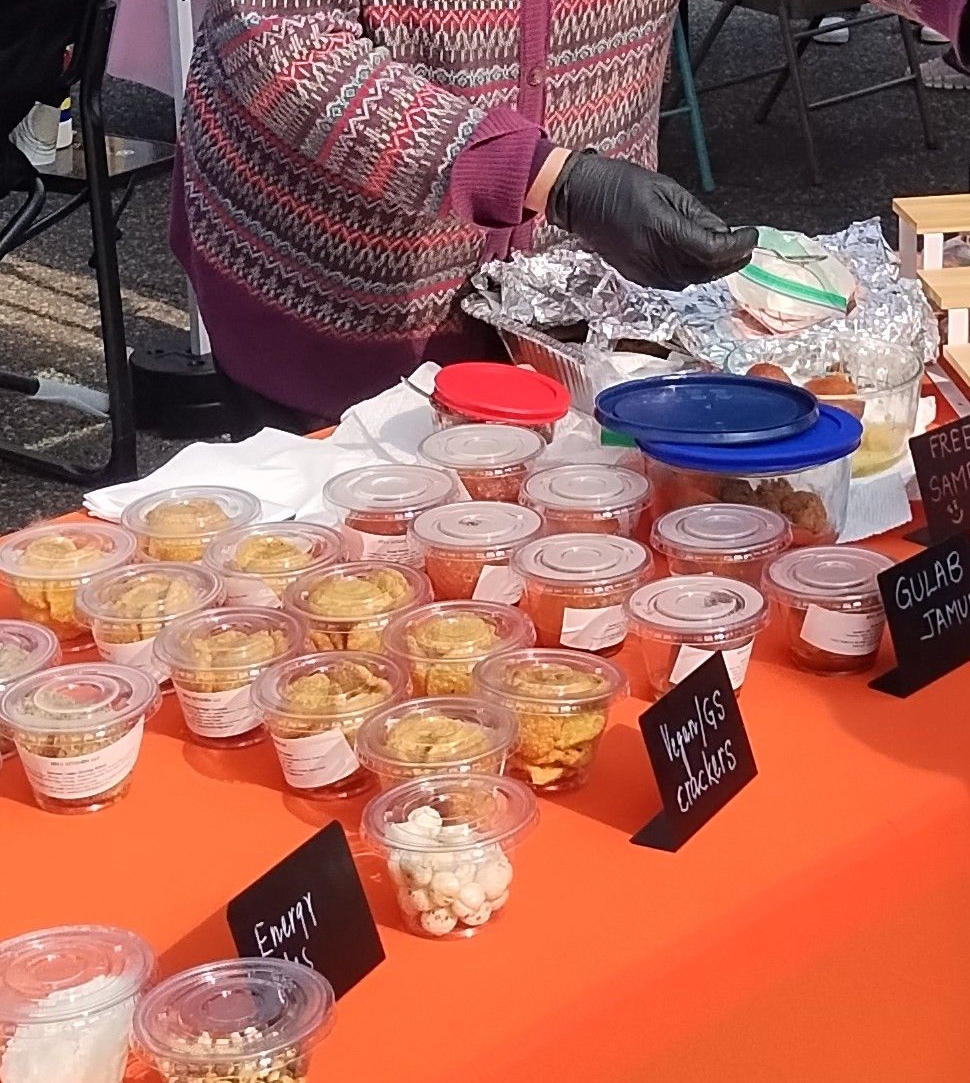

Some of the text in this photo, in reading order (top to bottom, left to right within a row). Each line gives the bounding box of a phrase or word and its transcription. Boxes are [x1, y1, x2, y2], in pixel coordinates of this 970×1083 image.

[895, 550, 963, 609] GULAB
[659, 689, 726, 776] Vegan/GS
[676, 739, 737, 813] crackers
[254, 891, 318, 958] Energy
